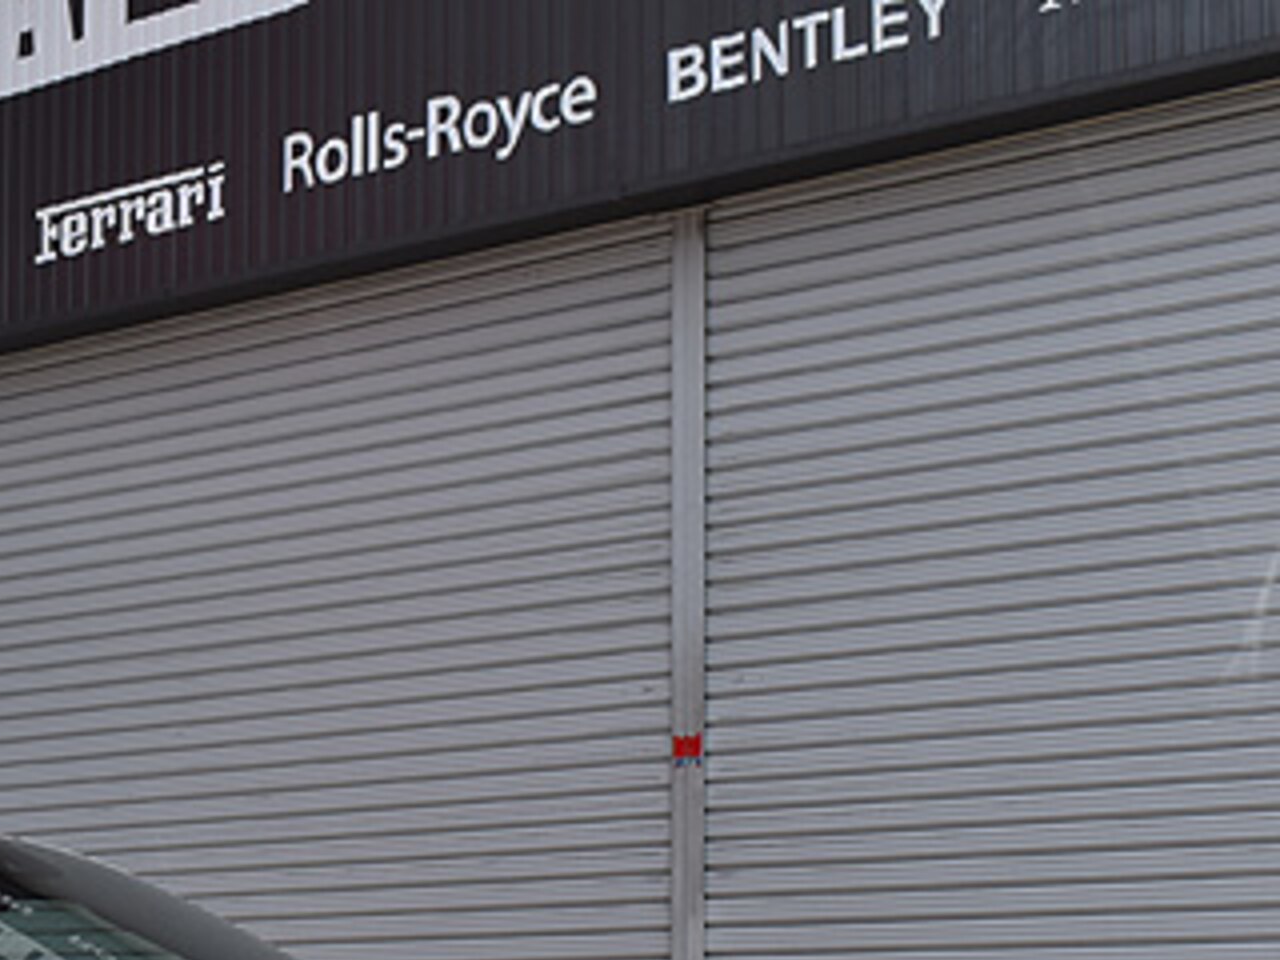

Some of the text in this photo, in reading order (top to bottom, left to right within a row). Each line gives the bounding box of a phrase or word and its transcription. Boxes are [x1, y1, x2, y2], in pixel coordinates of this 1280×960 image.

[667, 0, 947, 103] BENTLEY
[283, 75, 597, 193] Rolls-Royce
[34, 161, 225, 265] Ferrari
